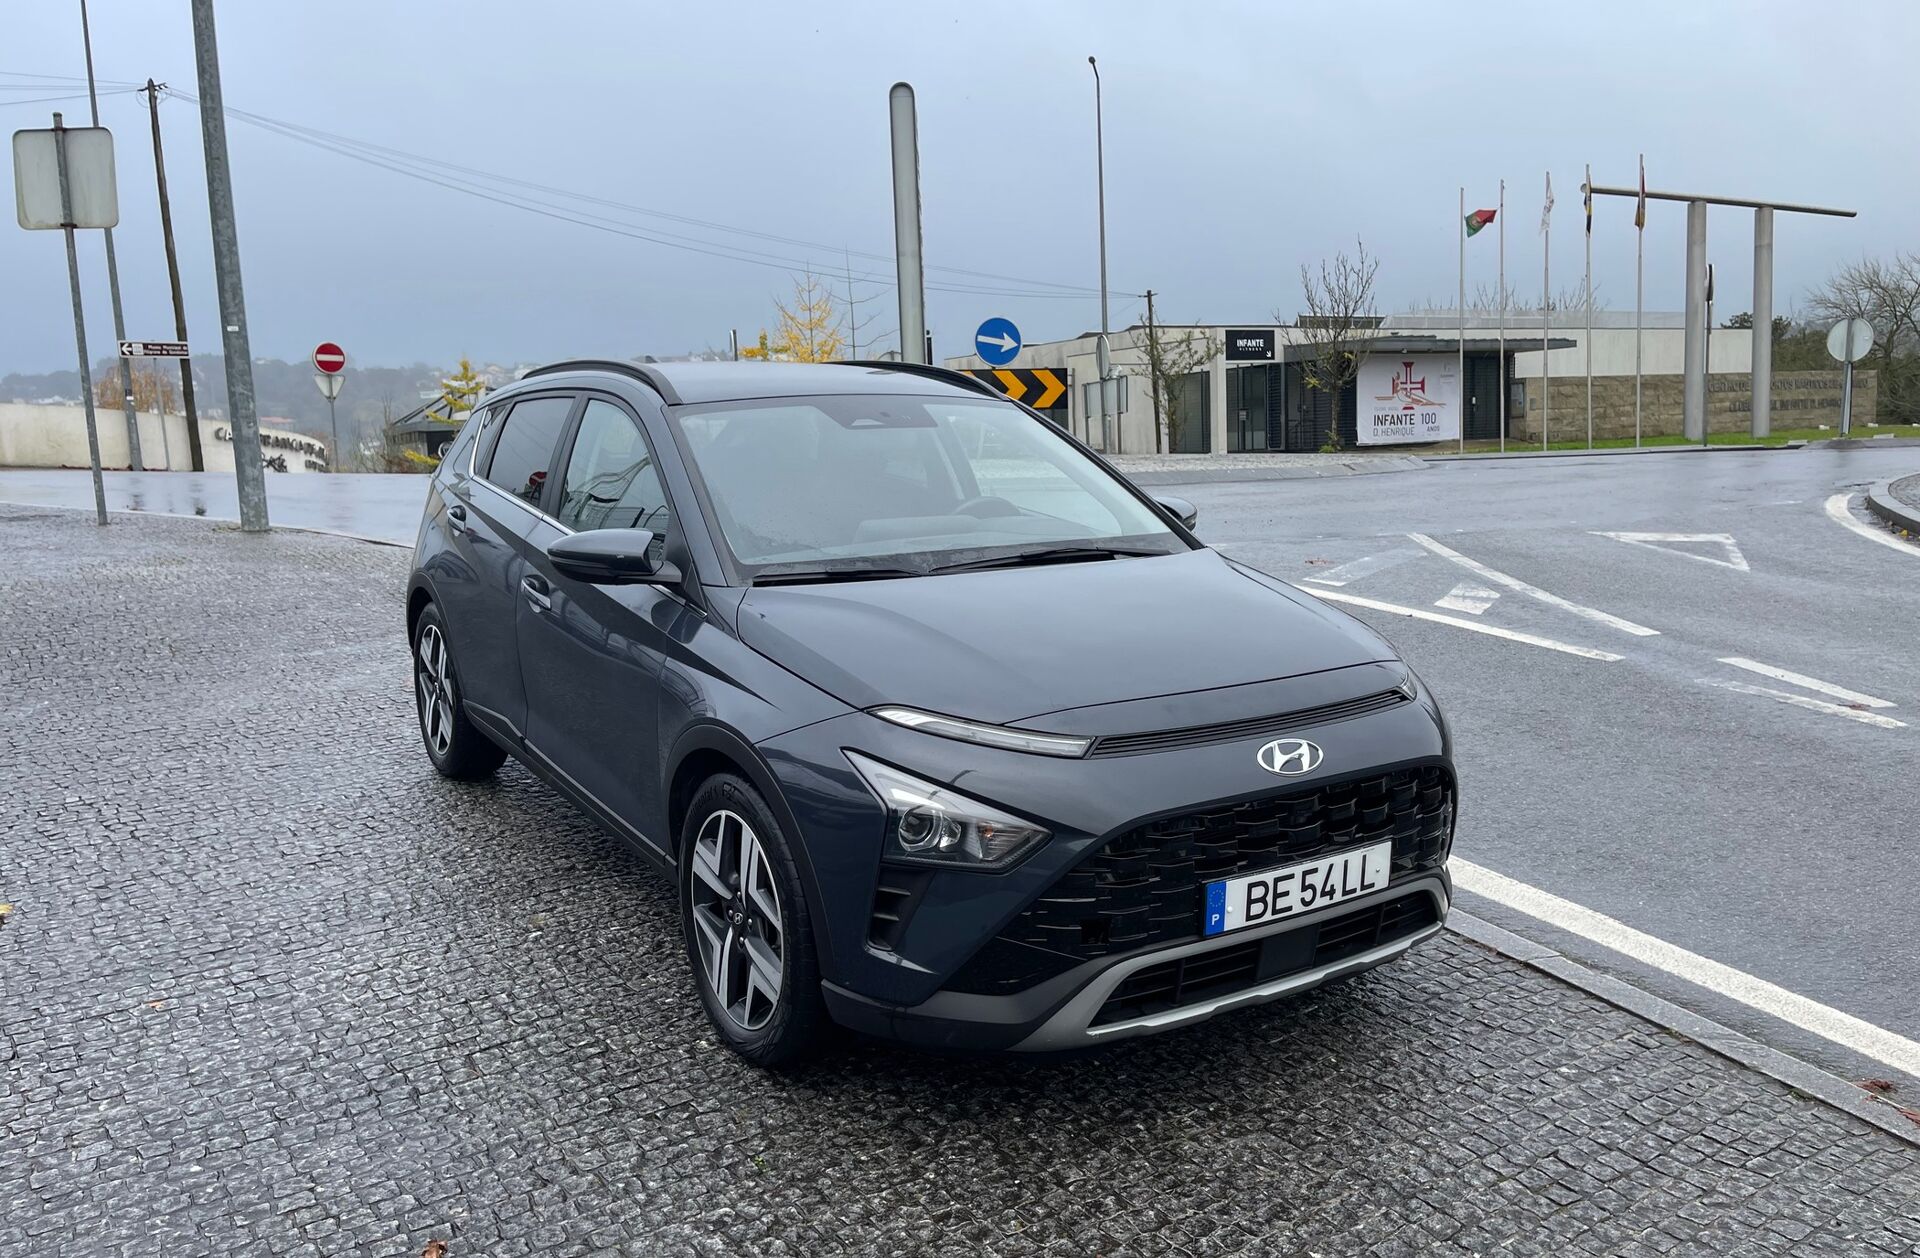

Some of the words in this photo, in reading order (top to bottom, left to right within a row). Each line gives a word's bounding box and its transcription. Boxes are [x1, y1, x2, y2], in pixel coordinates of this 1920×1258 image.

[1236, 338, 1264, 347] INFANTE
[1373, 414, 1415, 426] INFANTE
[1421, 413, 1437, 424] 100
[1373, 428, 1379, 437] D.
[1381, 427, 1415, 437] HENRIQUE
[1211, 913, 1220, 925] P
